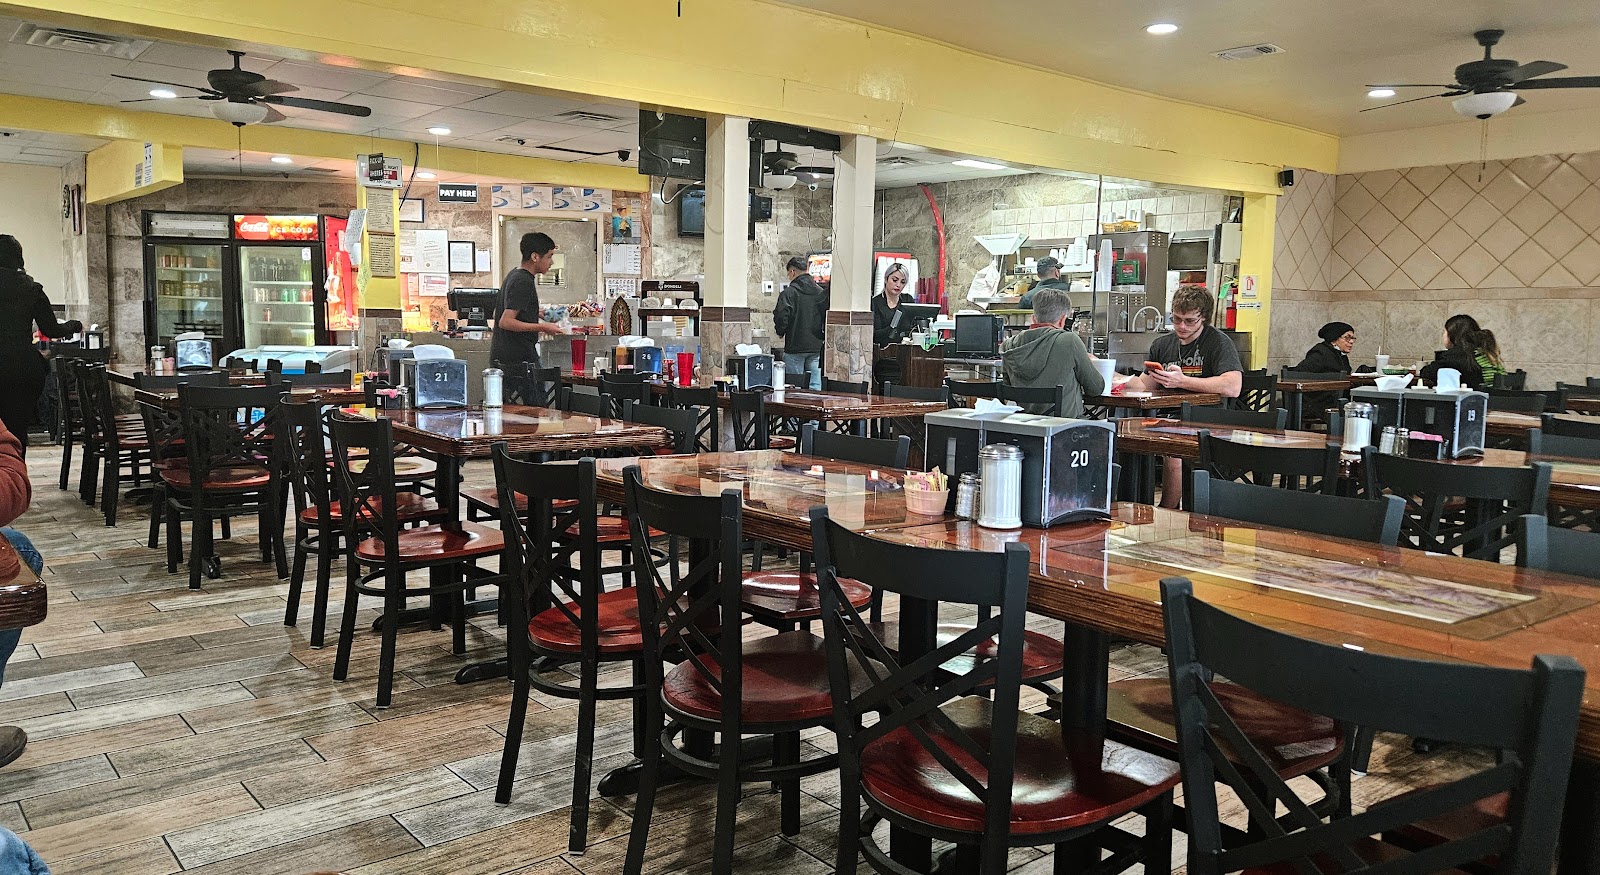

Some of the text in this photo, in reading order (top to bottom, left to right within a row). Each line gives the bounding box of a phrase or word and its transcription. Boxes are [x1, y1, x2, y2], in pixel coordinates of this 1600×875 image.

[439, 189, 477, 198] PAY HERE
[290, 226, 313, 234] COLD
[435, 372, 448, 382] 21
[1070, 449, 1089, 468] 20
